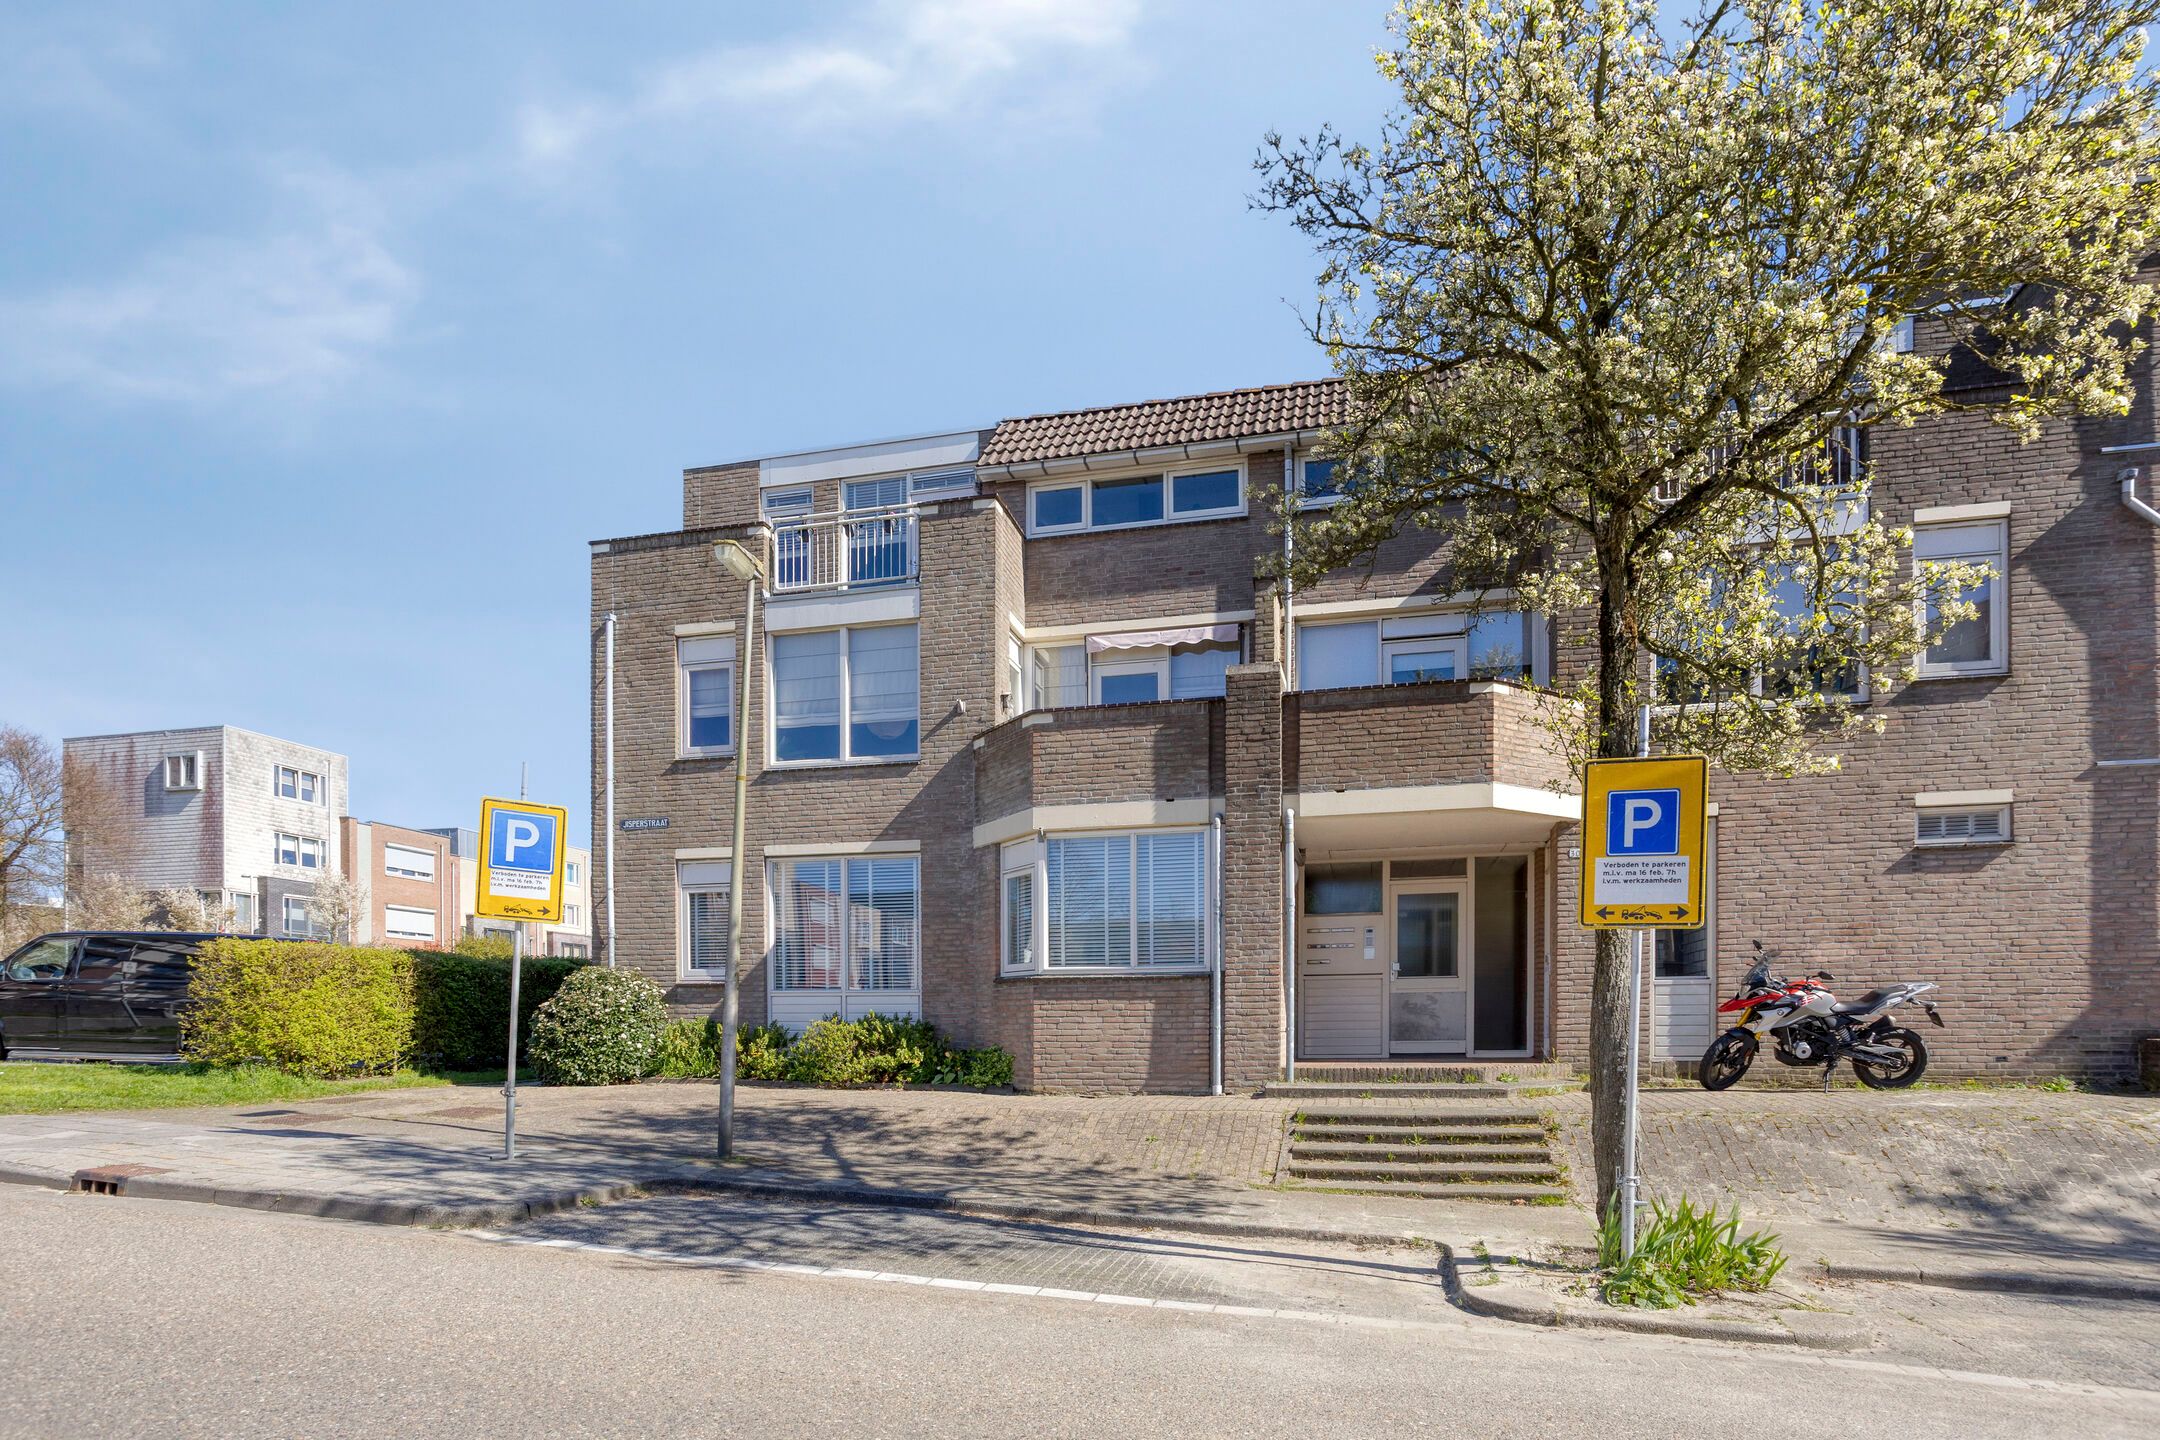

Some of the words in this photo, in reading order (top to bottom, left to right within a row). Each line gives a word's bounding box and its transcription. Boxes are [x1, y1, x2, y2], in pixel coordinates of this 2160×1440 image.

[505, 819, 540, 862] P
[623, 819, 668, 828] JISPERSTRAAT
[1624, 798, 1662, 848] P
